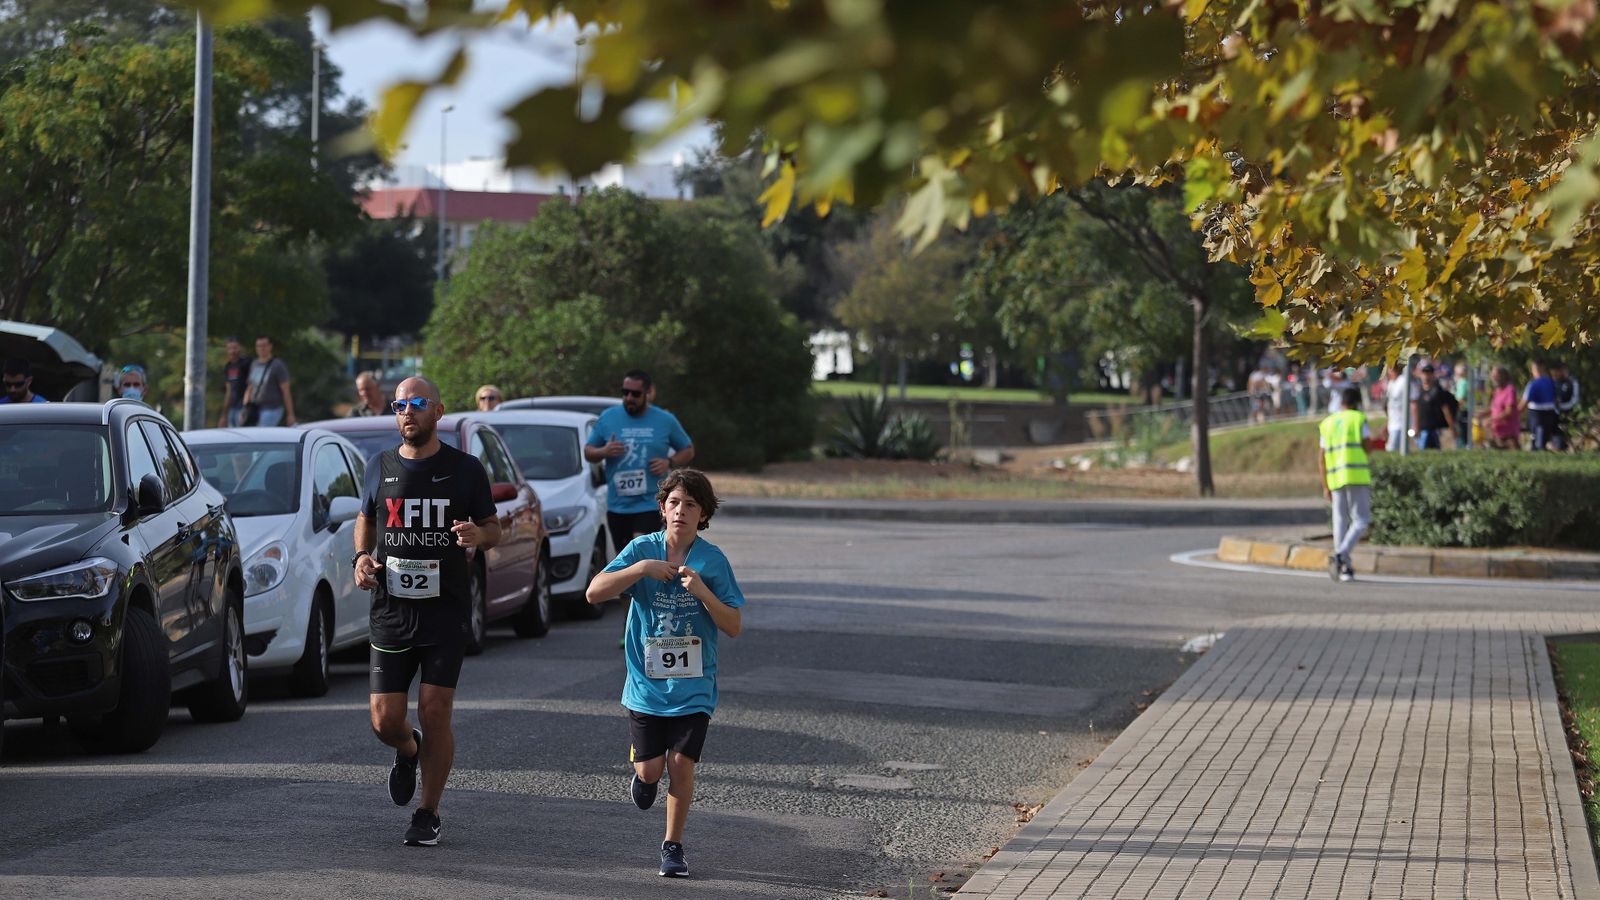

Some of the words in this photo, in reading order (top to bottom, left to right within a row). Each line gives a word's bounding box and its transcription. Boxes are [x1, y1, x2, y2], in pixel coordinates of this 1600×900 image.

[619, 478, 643, 489] 207
[385, 498, 450, 528] XFIT
[385, 532, 450, 546] RUNNERS
[400, 573, 428, 589] 92
[662, 651, 688, 668] 91
